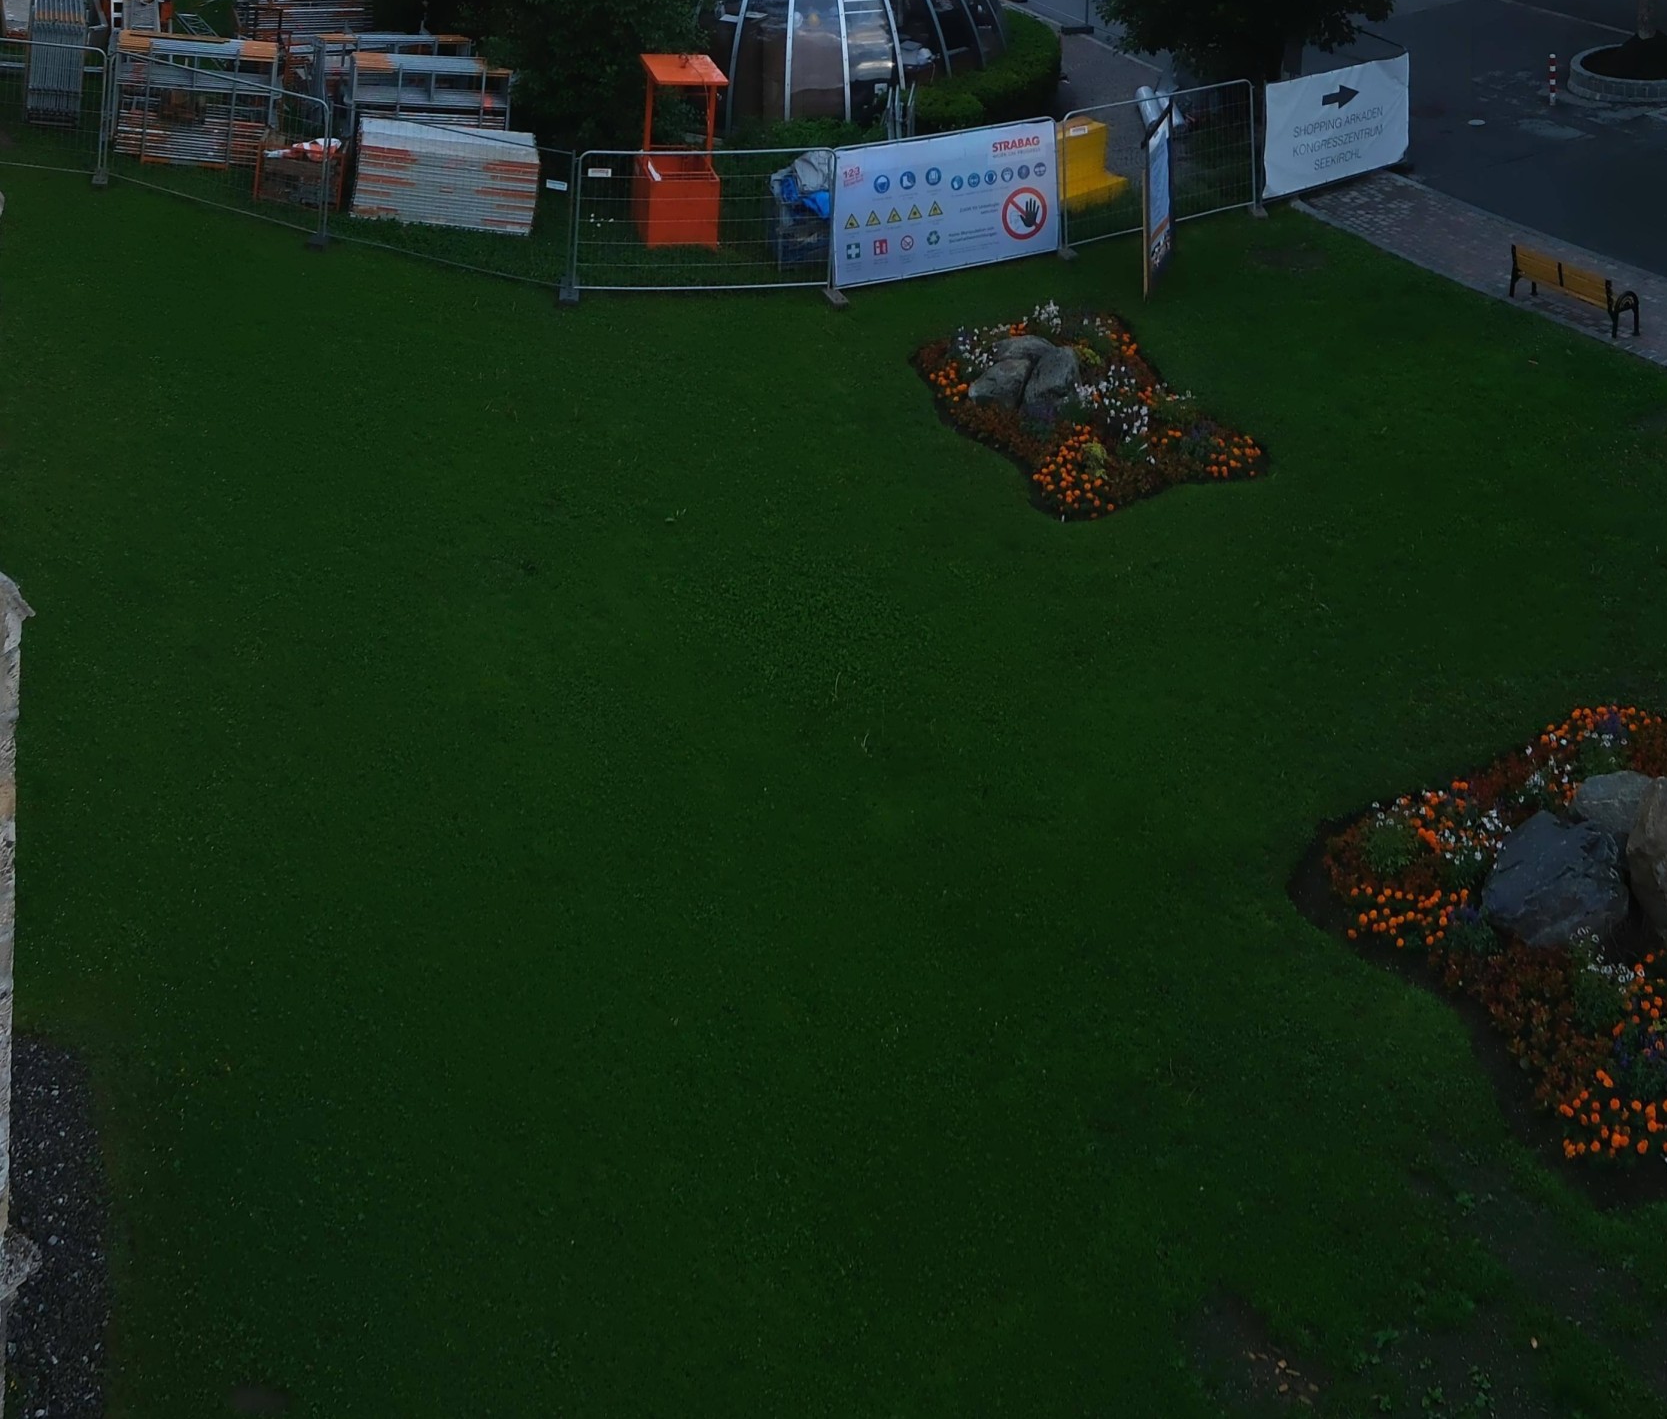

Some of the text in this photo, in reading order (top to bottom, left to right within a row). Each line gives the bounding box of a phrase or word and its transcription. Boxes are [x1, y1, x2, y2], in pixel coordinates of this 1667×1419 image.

[1293, 106, 1383, 138] SHOPPING ARKADEN
[992, 136, 1040, 152] STRABAG
[1292, 124, 1384, 157] KONGRESSZENTRUM
[1314, 148, 1362, 171] SEEKIRCHL
